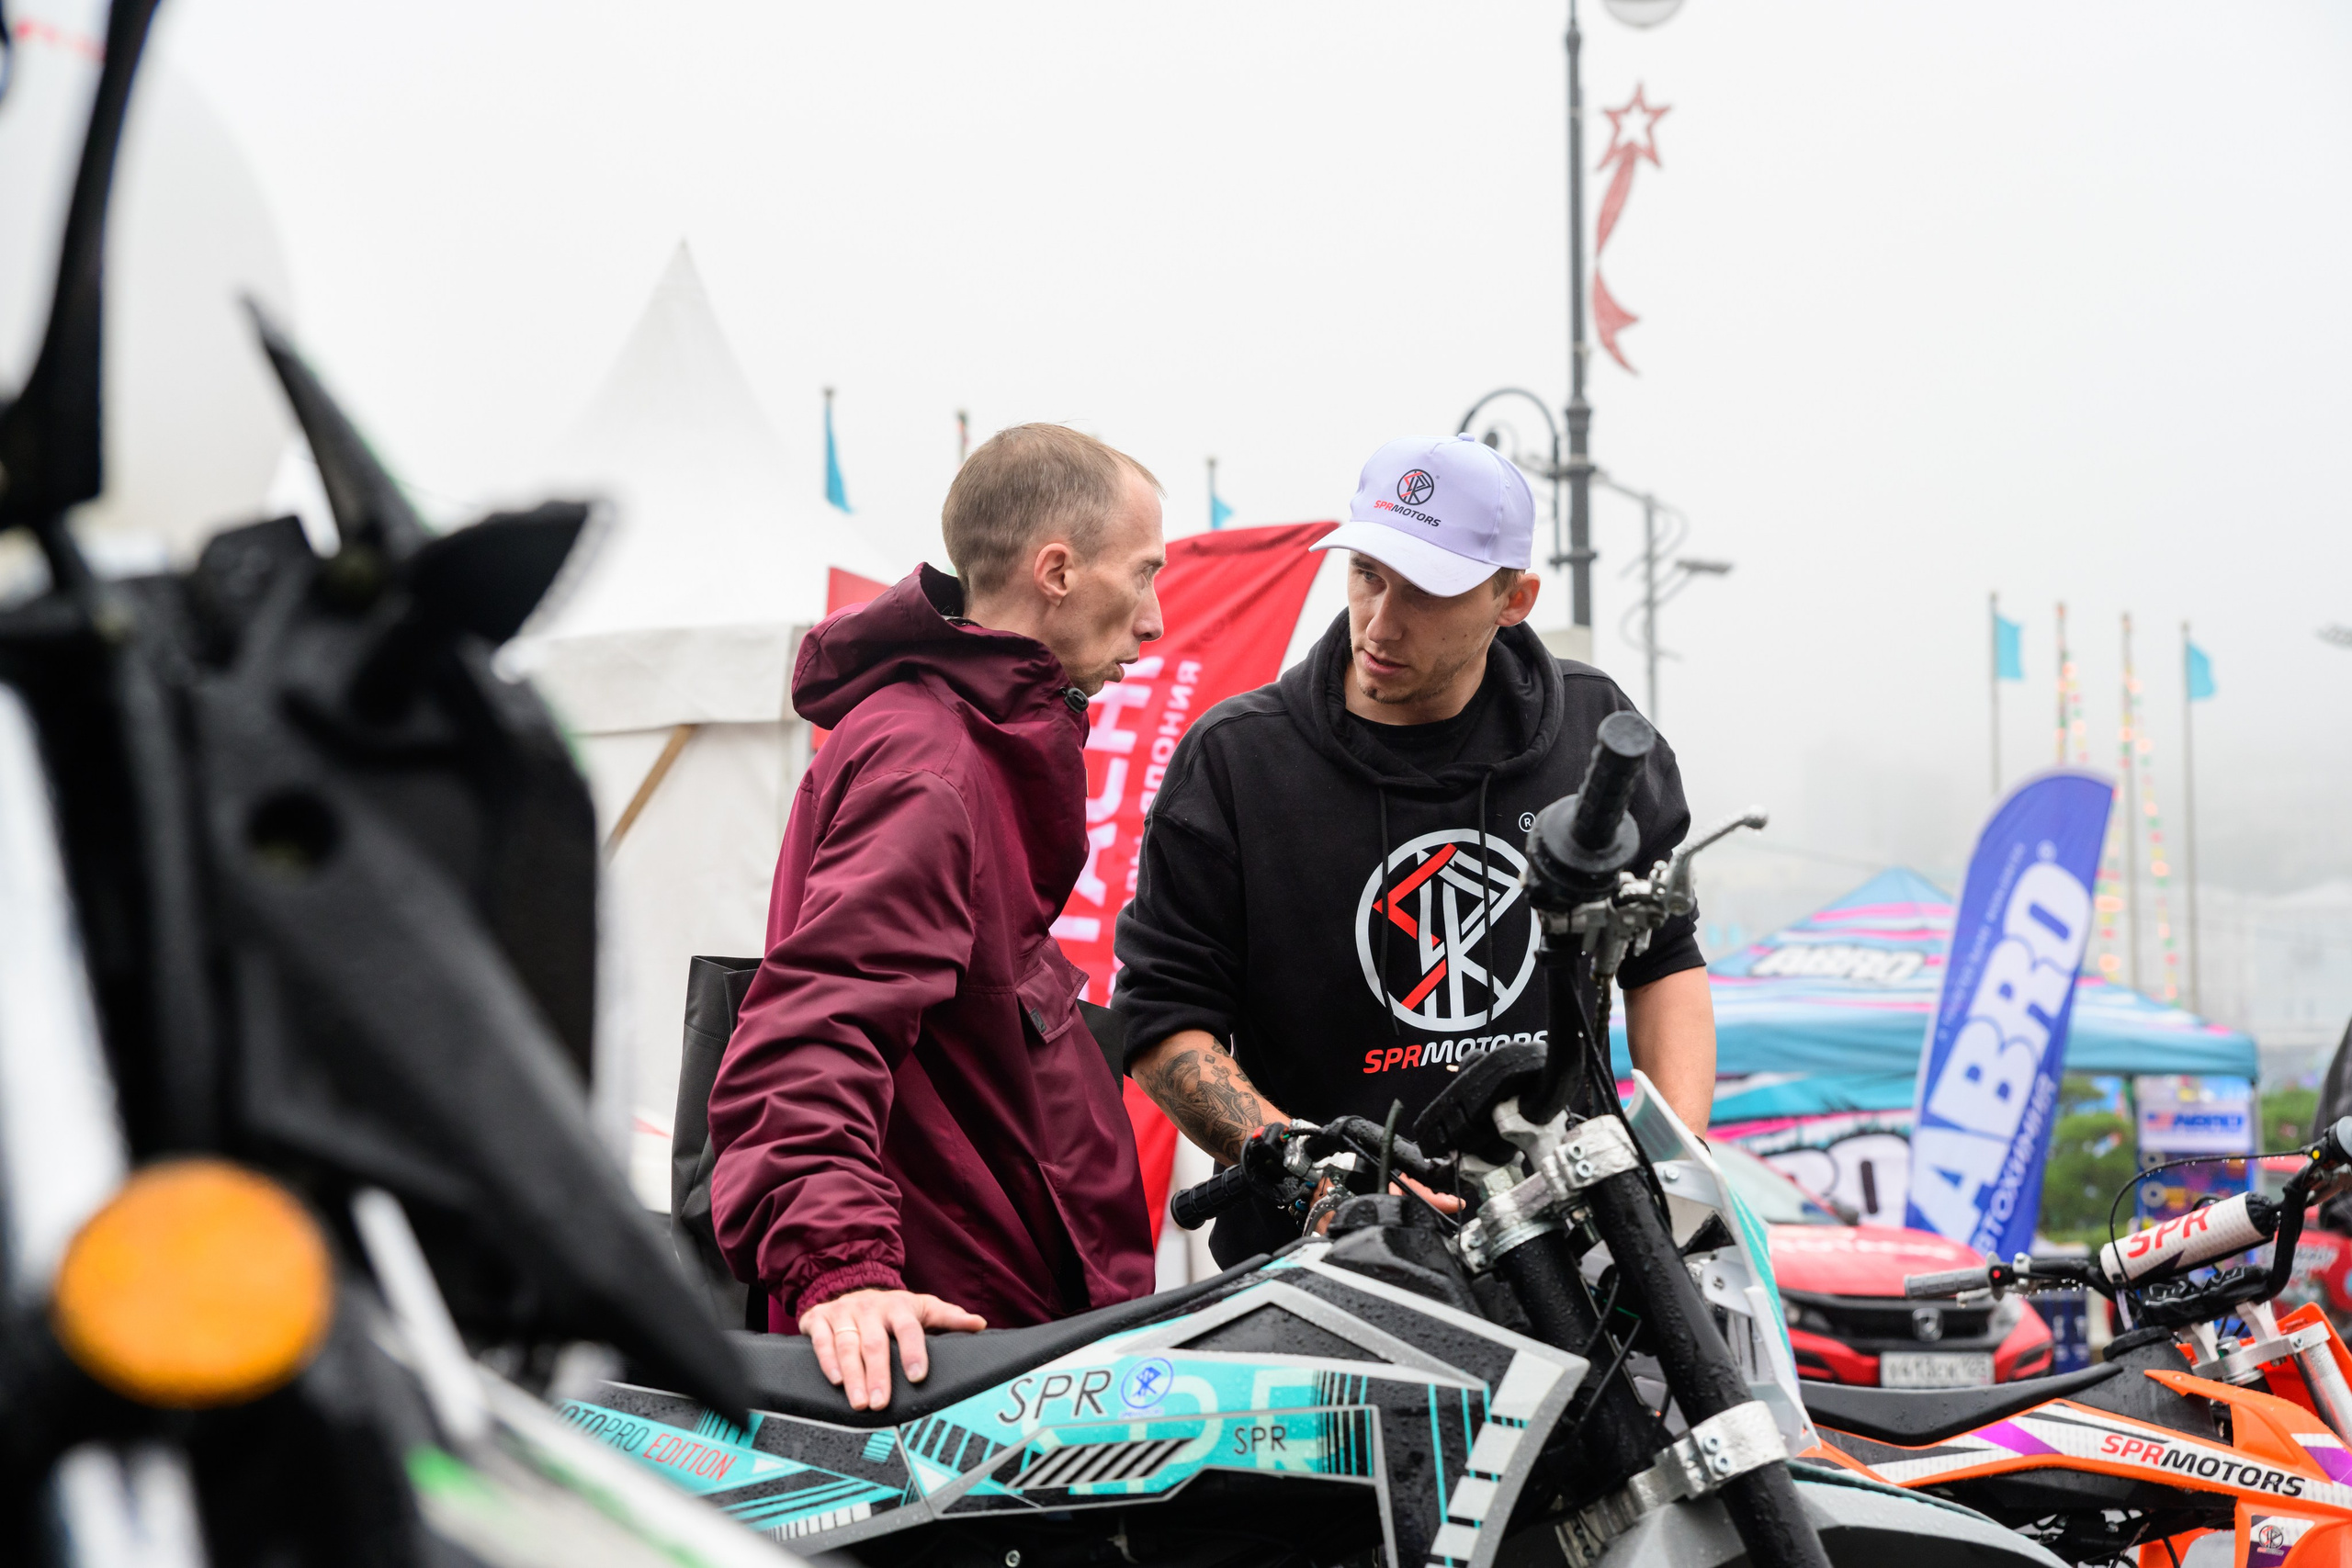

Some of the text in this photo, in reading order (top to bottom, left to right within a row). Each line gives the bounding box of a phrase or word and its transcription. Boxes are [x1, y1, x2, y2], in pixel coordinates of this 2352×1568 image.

[1374, 500, 1442, 527] SPRMOTORS
[1971, 1071, 2057, 1260] ВТОХИМИЯ
[2127, 1205, 2213, 1258] SPR
[998, 1369, 1112, 1424] SPR
[642, 1433, 737, 1482] EDITION
[1233, 1425, 1287, 1456] SPR
[2100, 1435, 2306, 1497] SPRMOTORS
